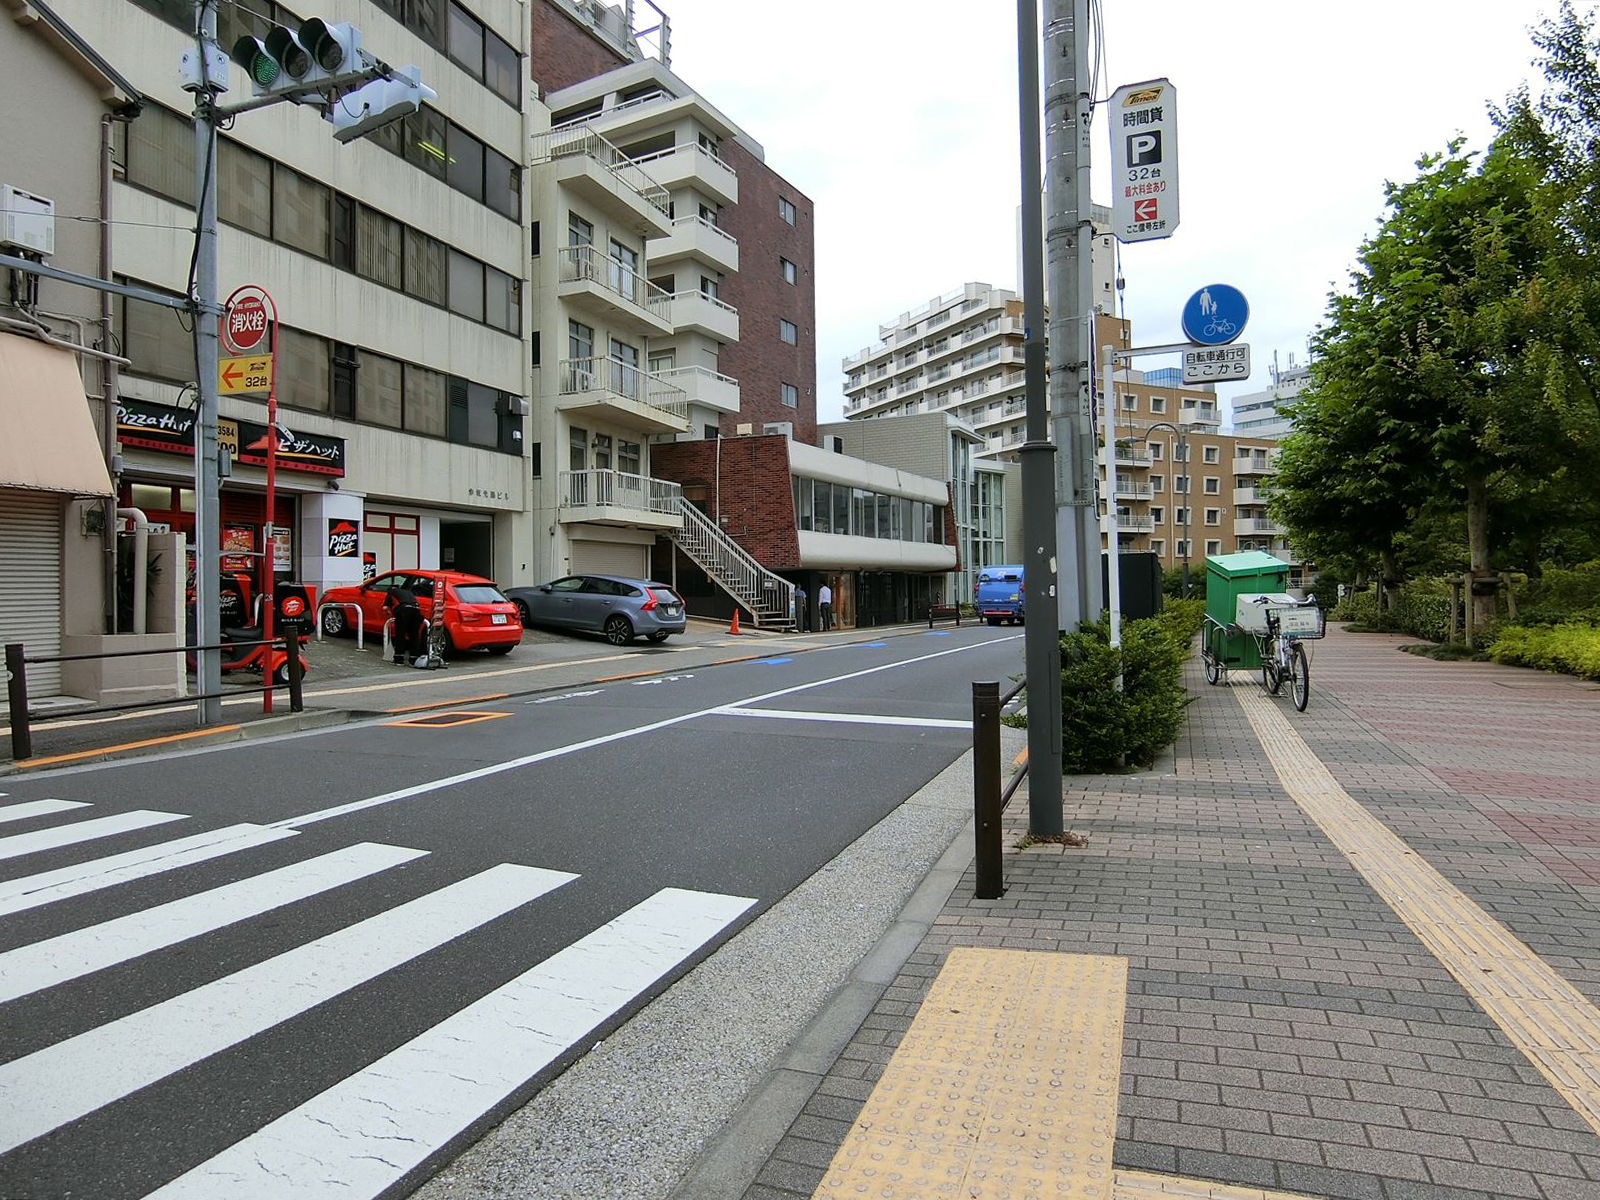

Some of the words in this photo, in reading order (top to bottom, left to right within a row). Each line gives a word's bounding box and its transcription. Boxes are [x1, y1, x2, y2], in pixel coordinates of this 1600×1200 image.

[1129, 91, 1159, 105] Times
[1123, 107, 1163, 127] 時間貸
[1131, 134, 1157, 165] P
[1128, 168, 1161, 182] 32台
[1125, 181, 1167, 198] 最大料金あり
[1126, 220, 1166, 234] ここ信号左折
[231, 310, 264, 333] 消火栓
[1186, 348, 1246, 364] 自転車通行可
[1187, 363, 1246, 377] ここから
[245, 376, 268, 387] 32台
[115, 406, 158, 427] Pizza
[158, 413, 192, 432] Hut
[217, 425, 234, 437] 3584
[217, 441, 237, 454] 00
[277, 438, 340, 459] ピザハット
[329, 532, 358, 549] Pizza
[334, 542, 355, 554] Hut
[220, 595, 237, 603] izza
